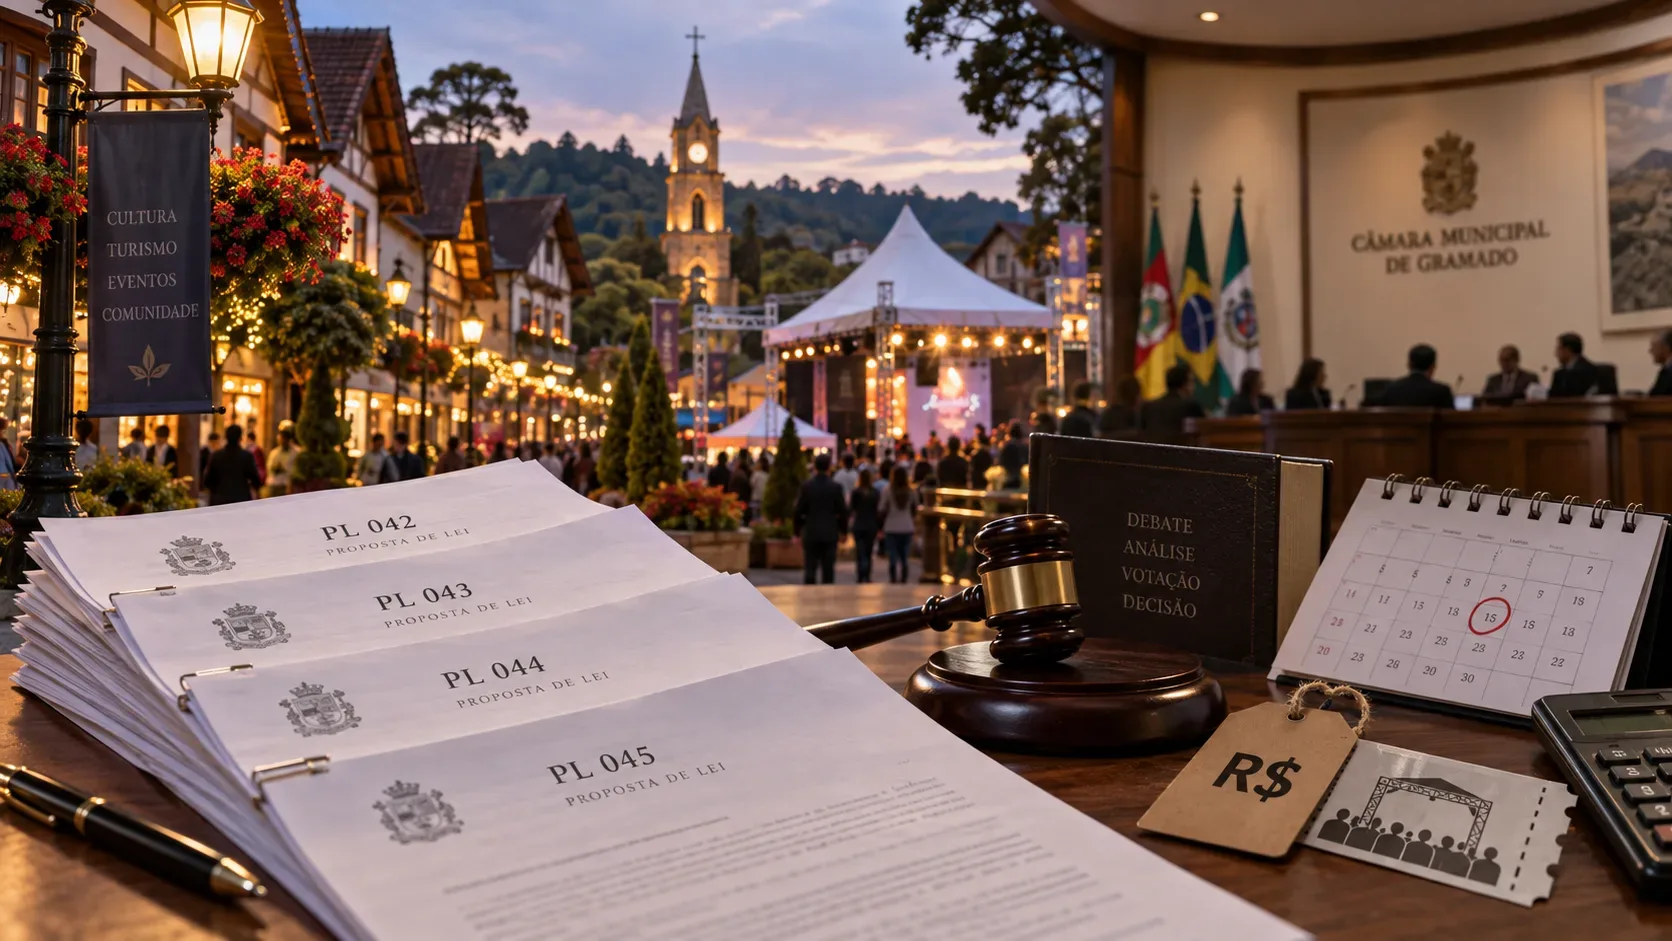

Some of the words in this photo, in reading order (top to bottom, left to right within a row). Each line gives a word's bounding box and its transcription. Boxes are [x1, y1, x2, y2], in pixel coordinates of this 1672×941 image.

[107, 209, 178, 226] CULTURA
[107, 240, 178, 257] TURISMO
[1350, 229, 1433, 253] CÂMARA
[1441, 220, 1550, 247] MUNICIPAL
[1386, 255, 1411, 275] DE
[1417, 247, 1518, 273] GRAMADO
[108, 272, 177, 290] EVENTOS
[102, 303, 199, 322] COMUNIDADE
[320, 523, 360, 541] PL
[367, 515, 417, 534] 042
[1127, 512, 1193, 534] DEBATE
[326, 538, 410, 556] PROPOSTA
[416, 532, 438, 542] DE
[444, 528, 470, 537] LEI
[1123, 539, 1196, 562] ANÁLISE
[1121, 566, 1200, 592] VOTAÇÃO
[373, 592, 416, 611] PL
[422, 583, 473, 603] 043
[1123, 594, 1197, 619] DECISÃO
[384, 608, 470, 629] PROPOSTA
[477, 602, 499, 613] DE
[506, 596, 533, 607] LEI
[440, 668, 485, 690] PL
[491, 656, 546, 680] 044
[456, 685, 545, 709] PROPOSTA
[551, 678, 576, 690] DE
[581, 671, 610, 684] LEI
[546, 760, 594, 785] PL
[599, 746, 656, 773] 045
[1212, 752, 1302, 802] R$
[565, 778, 660, 807] PROPOSTA
[665, 770, 690, 784] DE
[696, 761, 727, 777] LEI
